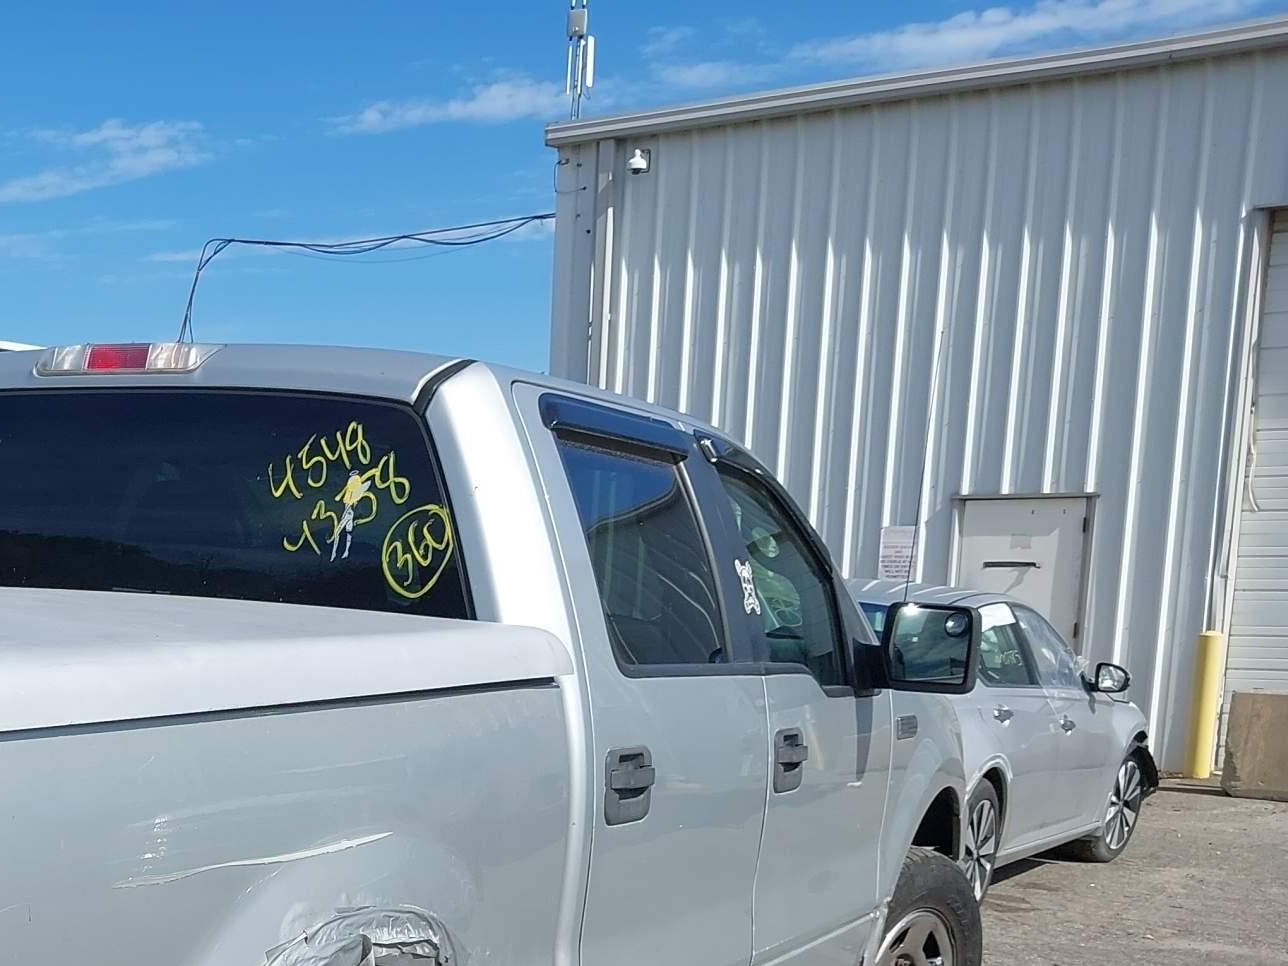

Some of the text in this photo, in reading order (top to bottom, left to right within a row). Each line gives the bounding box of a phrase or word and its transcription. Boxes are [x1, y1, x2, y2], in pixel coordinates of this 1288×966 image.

[268, 421, 370, 499] 4548
[283, 451, 410, 556] 4358
[386, 508, 451, 586] 360
